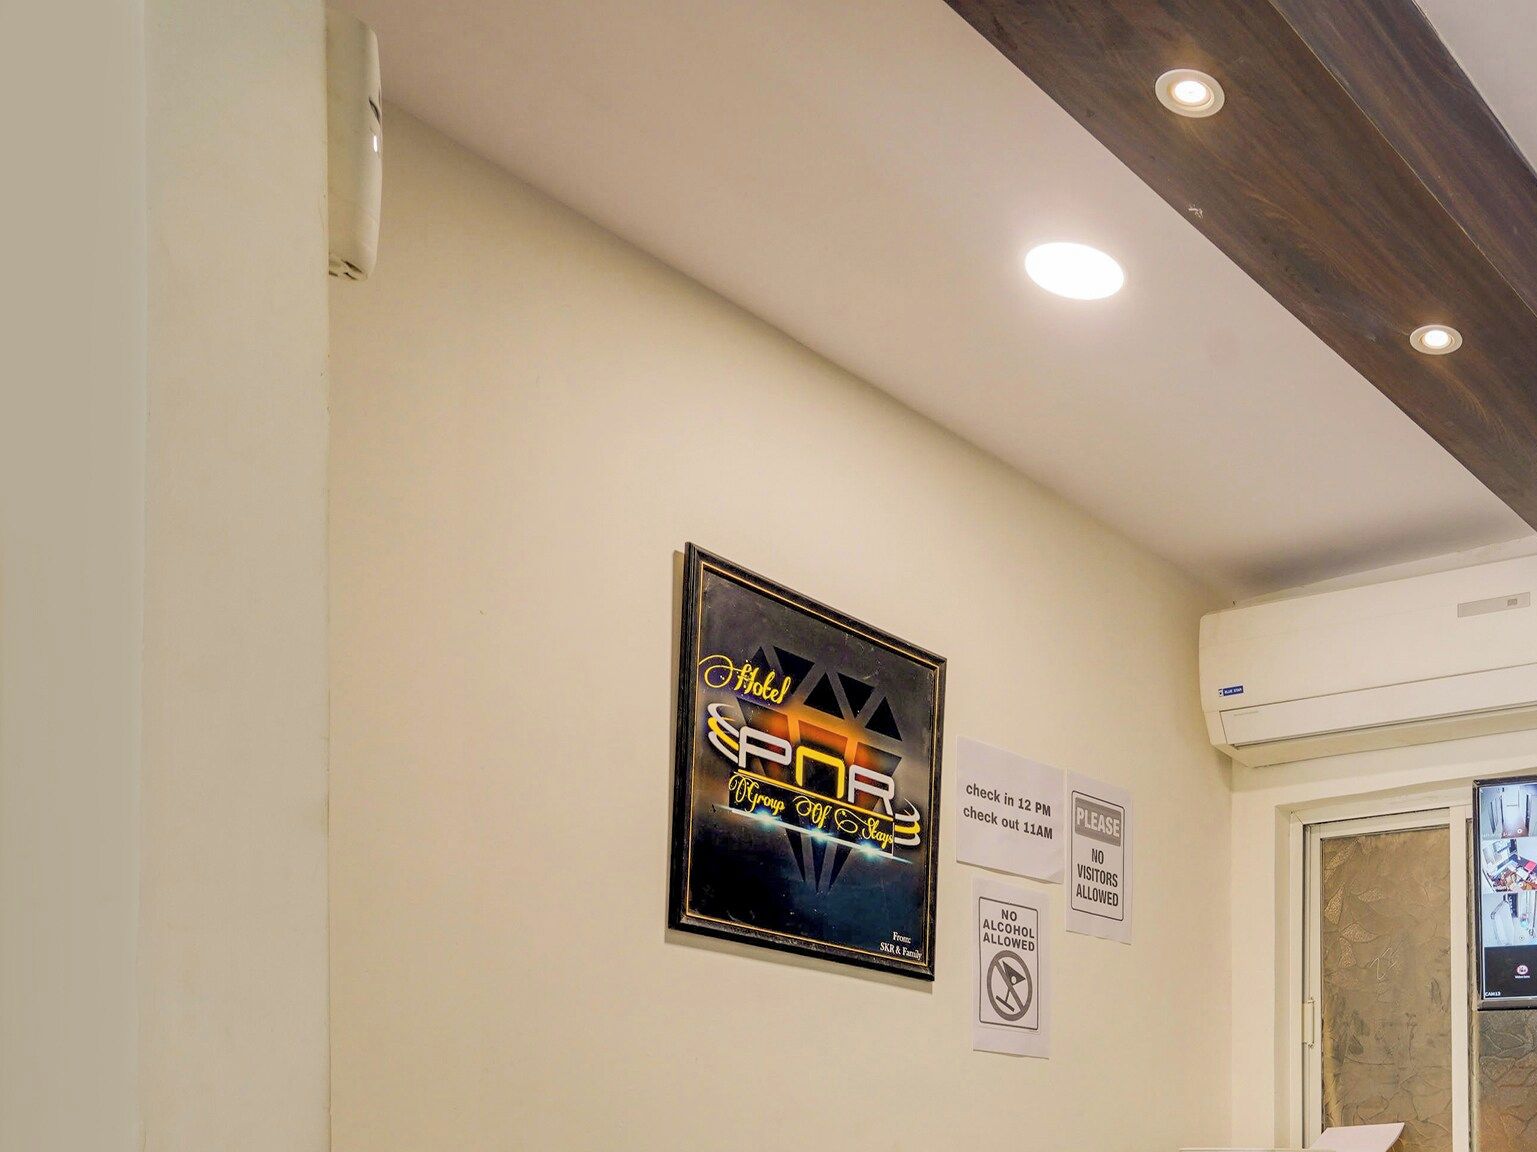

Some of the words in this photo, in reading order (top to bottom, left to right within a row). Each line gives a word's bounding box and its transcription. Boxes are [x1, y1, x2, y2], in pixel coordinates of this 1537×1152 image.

[699, 655, 791, 704] Hotel
[966, 783, 1000, 803] check
[1004, 793, 1014, 807] in
[1018, 798, 1031, 811] 12
[1035, 802, 1051, 817] PM
[834, 808, 893, 849] Stays
[963, 806, 998, 825] check
[1001, 818, 1020, 831] out
[1023, 822, 1053, 839] 11AM
[1077, 807, 1120, 838] PLEASE
[1091, 848, 1104, 865] NO
[1077, 863, 1118, 888] VISITORS
[1076, 883, 1119, 907] ALLOWED
[1001, 909, 1017, 922] NO
[983, 919, 1035, 939] ALCOHOL
[983, 932, 1035, 951] ALLOWED
